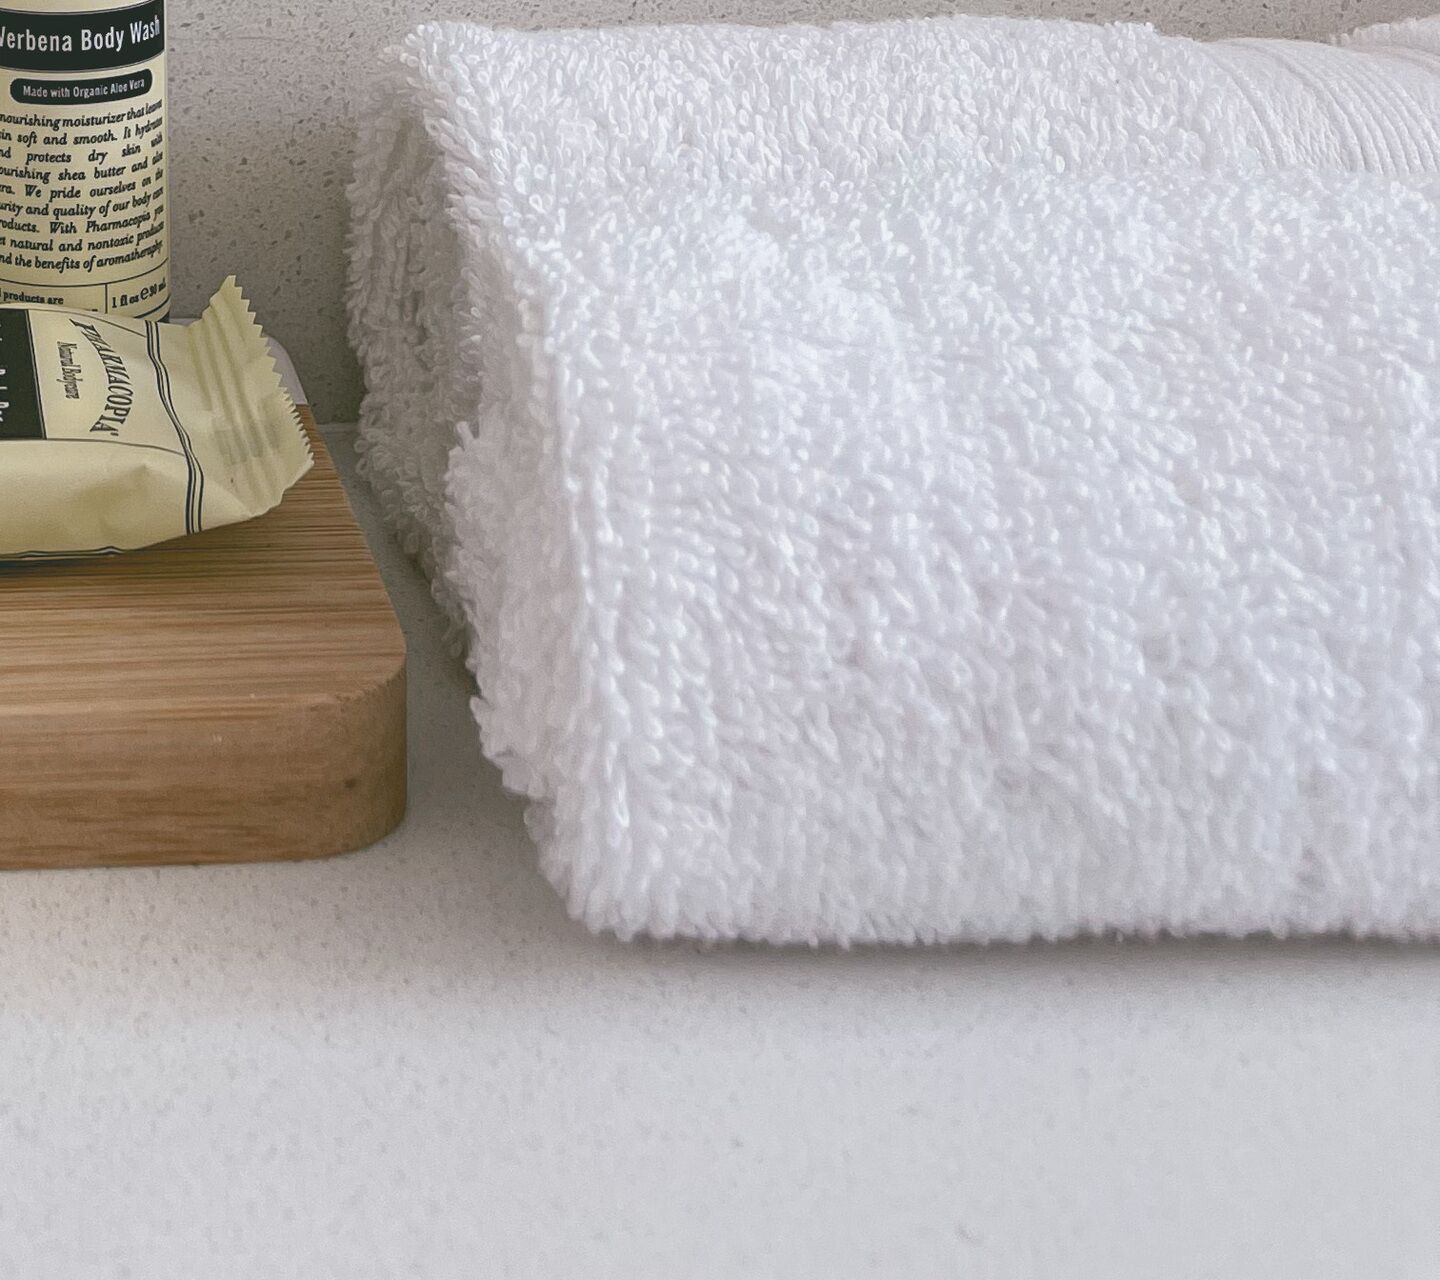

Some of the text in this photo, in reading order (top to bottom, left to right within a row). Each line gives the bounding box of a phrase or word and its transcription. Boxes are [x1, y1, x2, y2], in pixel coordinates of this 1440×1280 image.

[81, 26, 125, 52] Body
[130, 15, 160, 44] Wash
[23, 77, 145, 98] Made with Organic Aloe Vera
[0, 114, 61, 131] nourishing
[62, 112, 126, 127] moisturizer
[17, 132, 37, 147] soft
[43, 133, 67, 145] and
[73, 132, 117, 145] smooth.
[26, 152, 71, 165] protects
[88, 150, 108, 165] dry
[122, 144, 141, 157] skin
[58, 169, 85, 181] shea
[94, 166, 126, 178] butter
[131, 157, 148, 172] and
[24, 181, 136, 202] We pride ourselves
[26, 203, 49, 216] and
[53, 205, 96, 221] quality
[99, 200, 111, 218] of
[112, 200, 130, 212] our
[132, 193, 151, 208] body
[49, 222, 77, 234] With
[10, 237, 82, 252] natural and
[15, 254, 32, 267] the
[35, 256, 80, 273] benefits
[83, 257, 97, 272] of
[57, 341, 81, 399] Natural Bodycare
[68, 318, 134, 434] PHARMACOPIA
